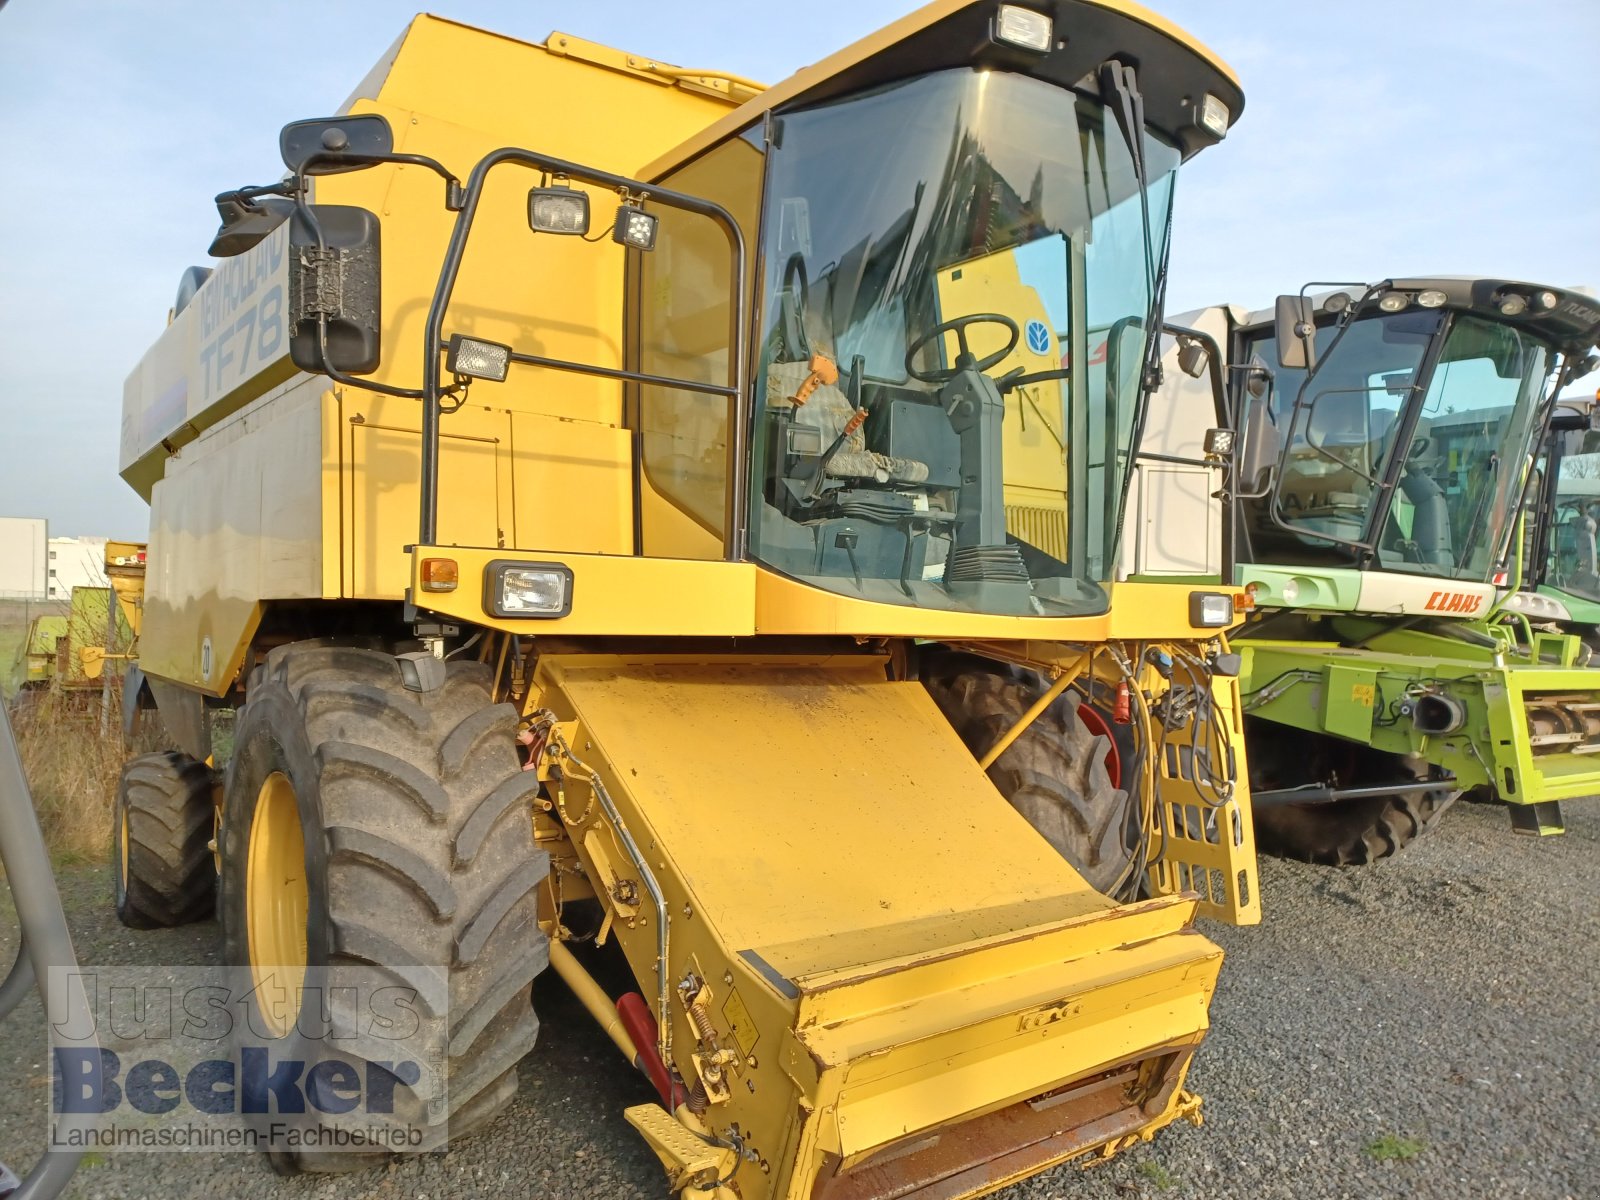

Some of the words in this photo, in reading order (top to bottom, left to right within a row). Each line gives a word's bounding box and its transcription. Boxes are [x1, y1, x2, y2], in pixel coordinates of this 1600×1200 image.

[200, 284, 283, 400] TF78
[1424, 591, 1483, 613] CLAAS
[203, 644, 210, 674] 20
